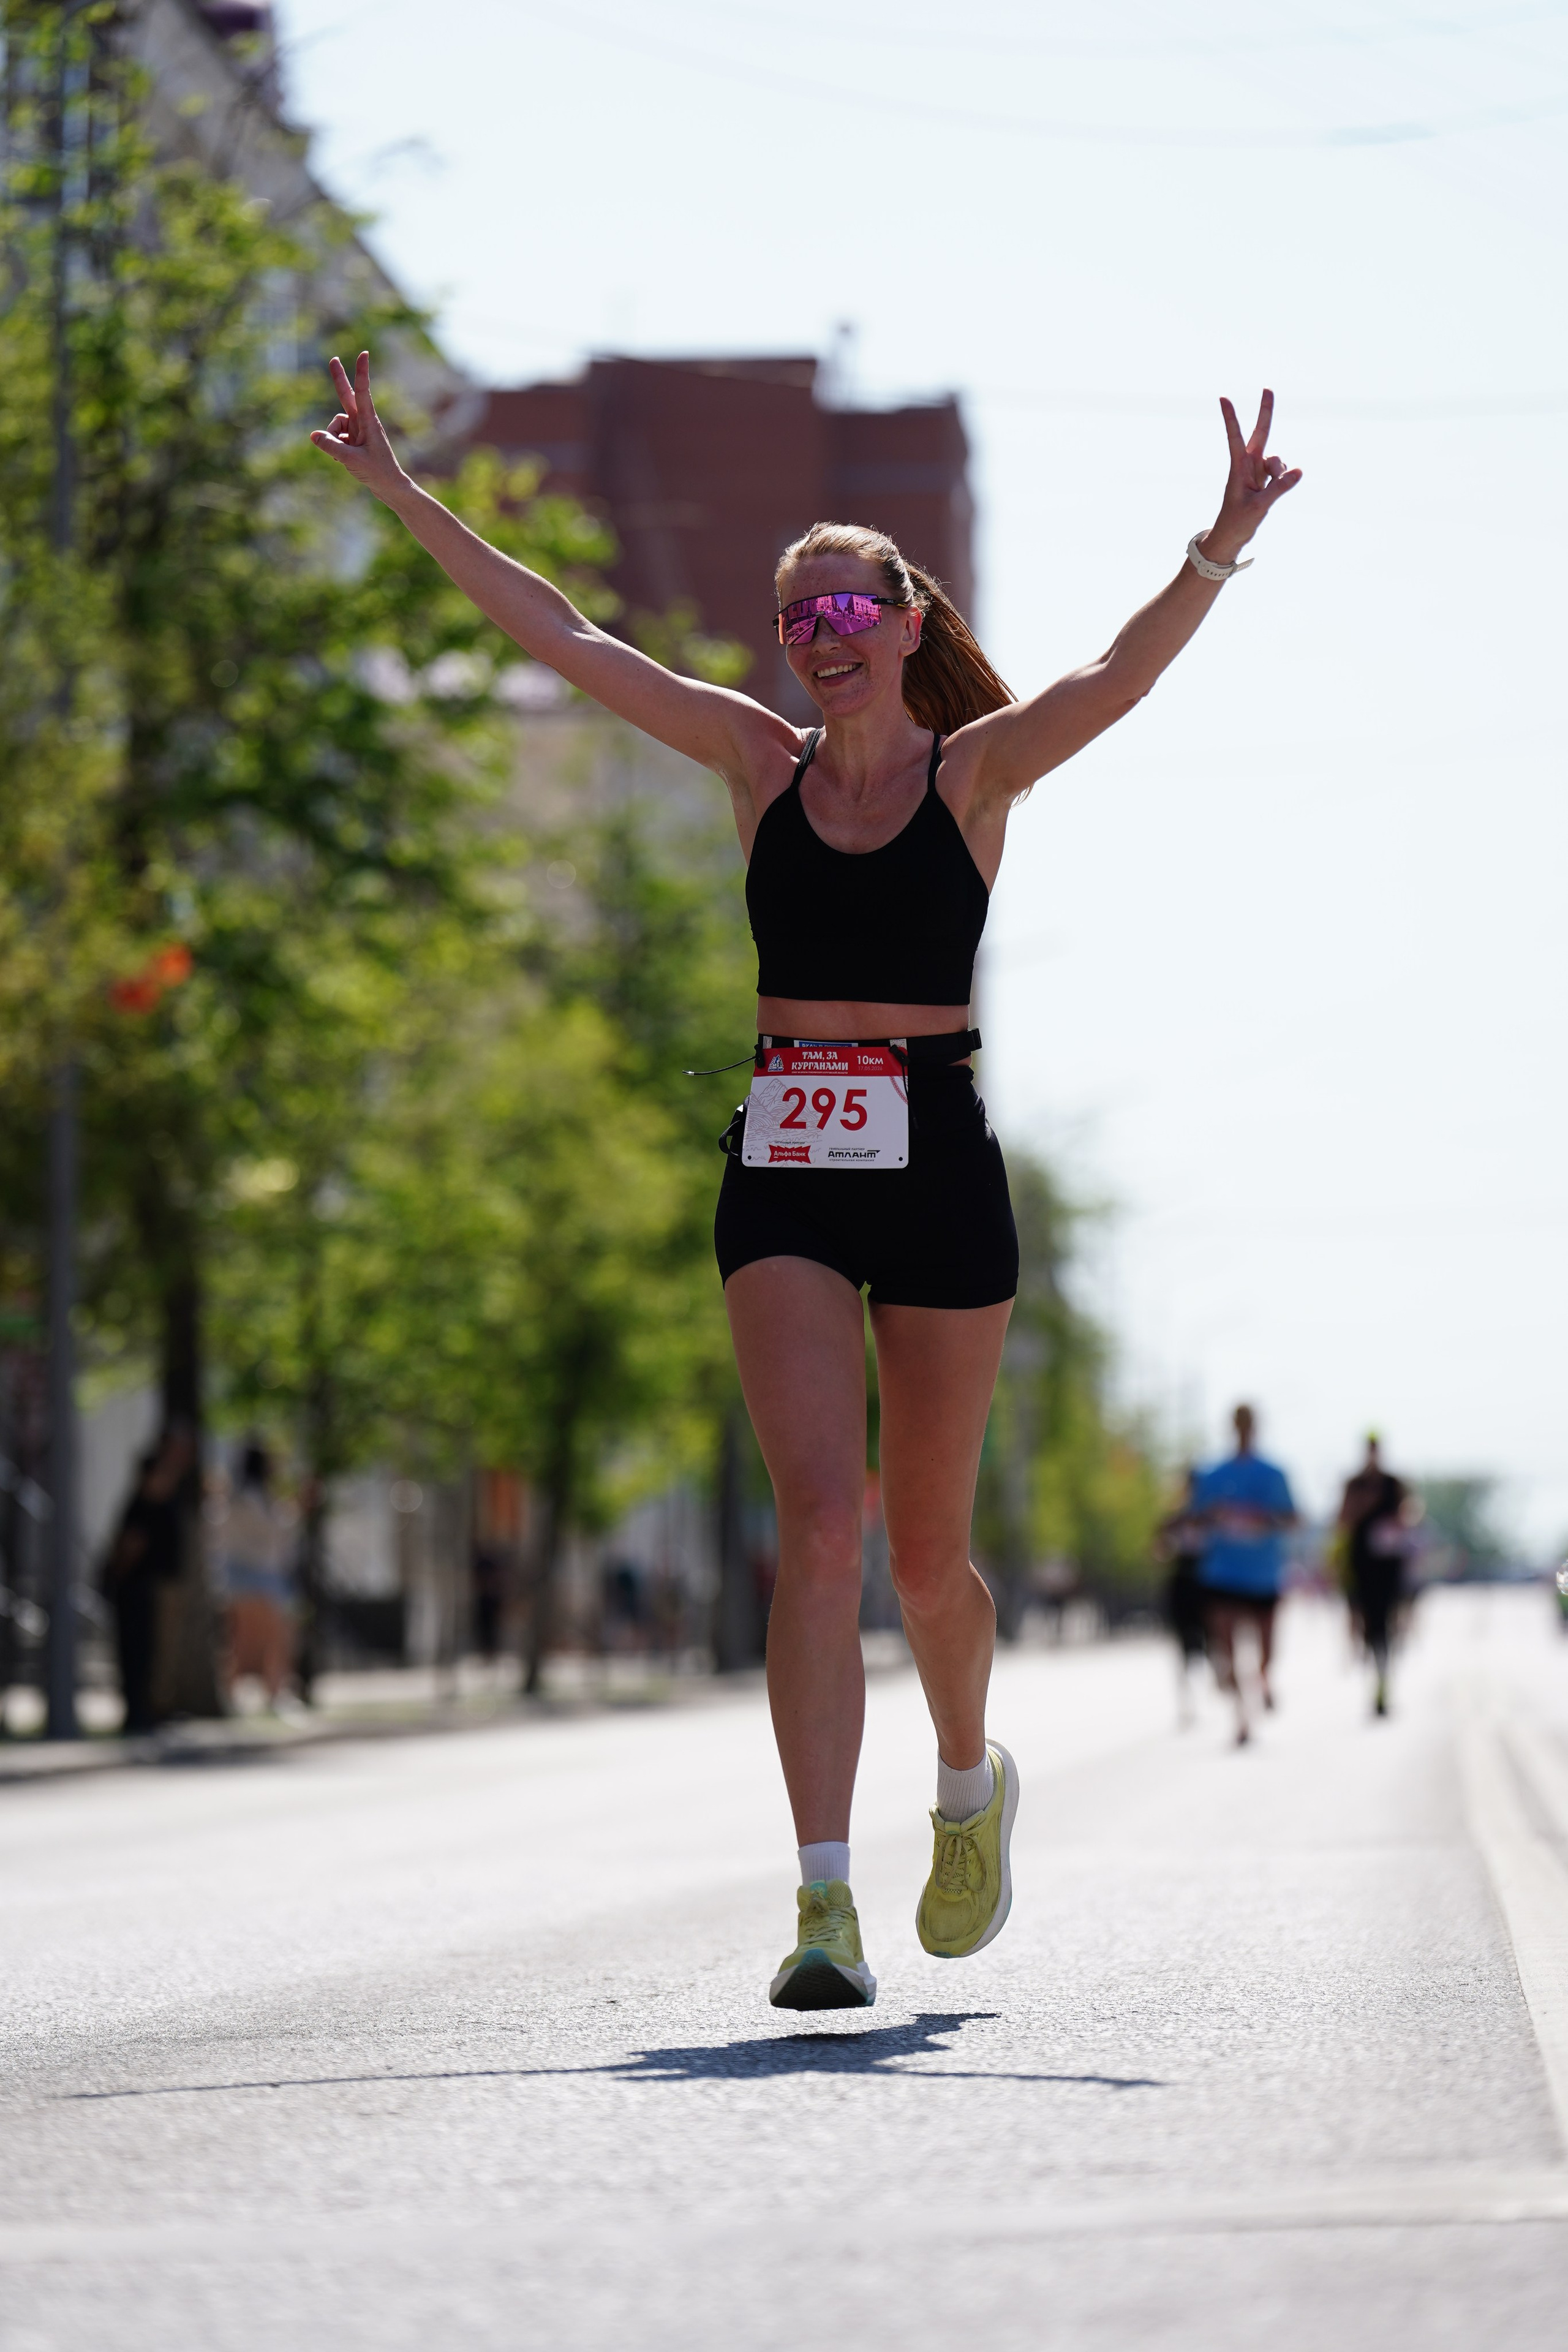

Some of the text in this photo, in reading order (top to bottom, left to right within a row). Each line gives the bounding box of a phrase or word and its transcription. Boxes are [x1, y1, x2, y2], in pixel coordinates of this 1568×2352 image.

[802, 1052, 824, 1061] ТАМ,
[791, 1062, 848, 1071] КУРГАНАМИ
[780, 1087, 867, 1131] 295
